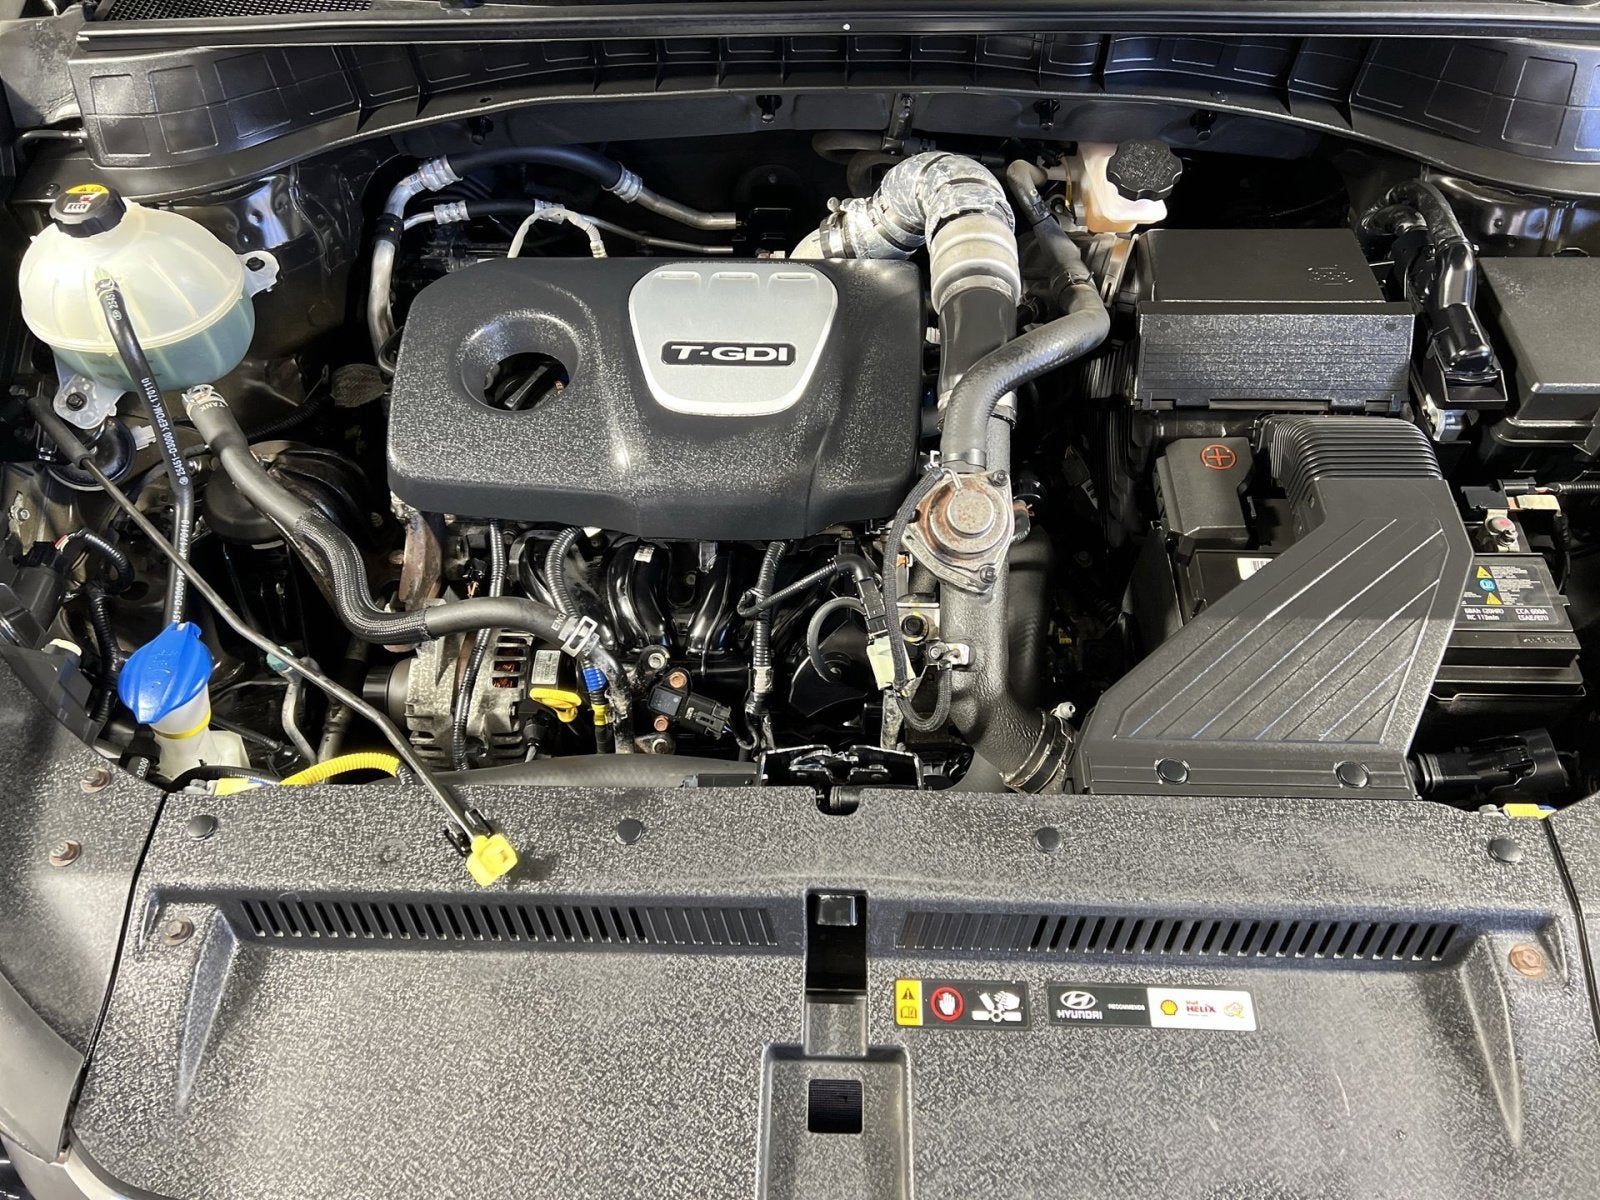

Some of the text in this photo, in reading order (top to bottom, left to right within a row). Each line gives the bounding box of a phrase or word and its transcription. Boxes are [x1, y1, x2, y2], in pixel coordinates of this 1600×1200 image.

[671, 345, 788, 362] T-GDI
[141, 377, 159, 403] 170110
[163, 431, 186, 477] 25451-D3000
[1056, 1009, 1103, 1020] HYUNDAI
[1186, 1003, 1216, 1013] HELIX
